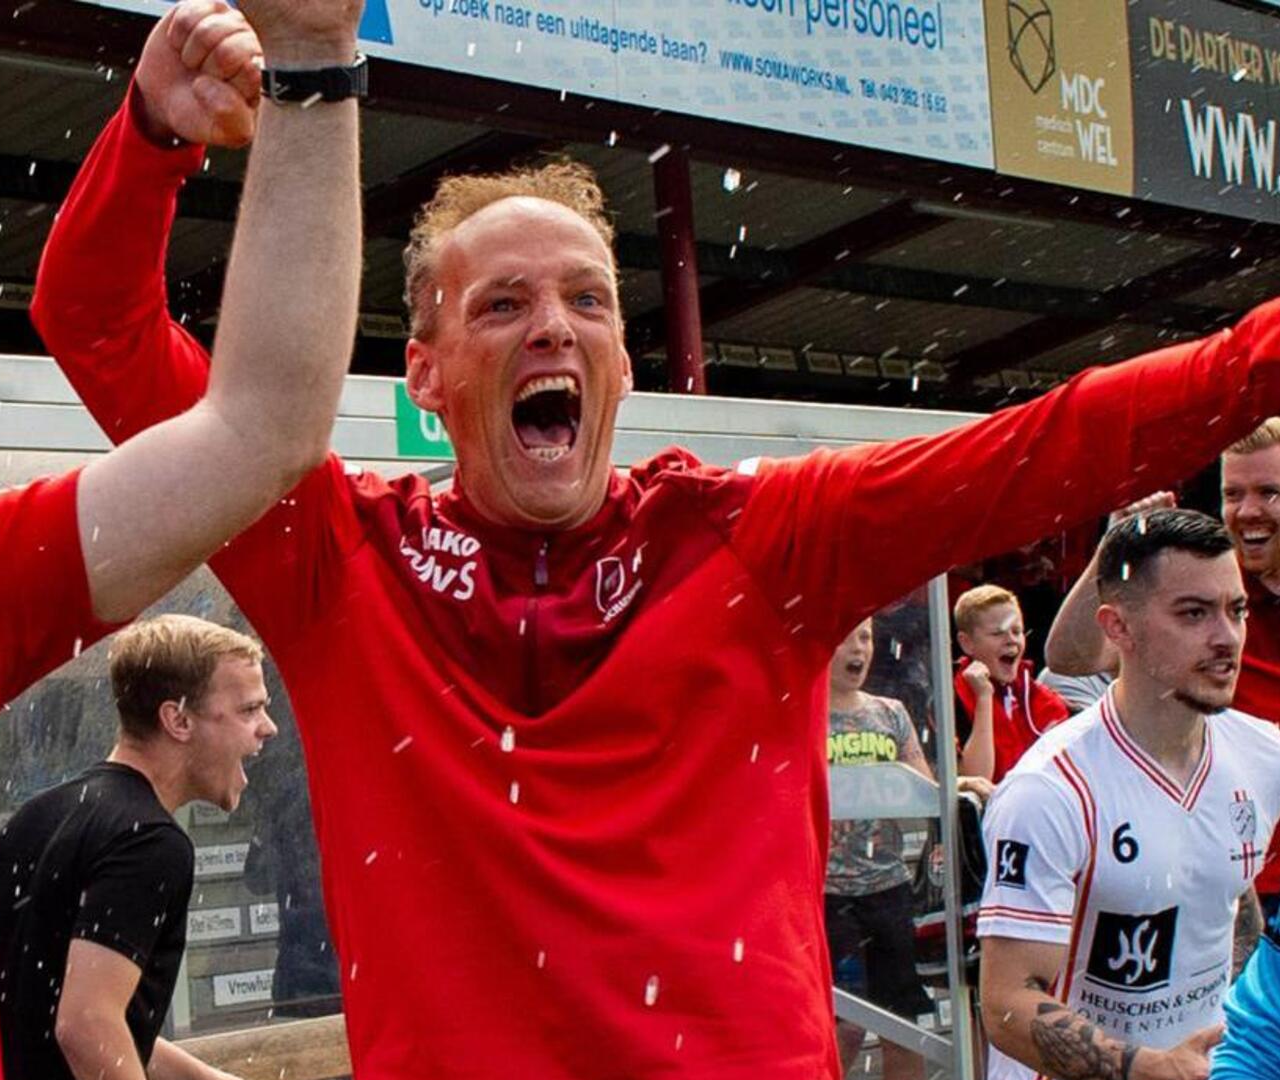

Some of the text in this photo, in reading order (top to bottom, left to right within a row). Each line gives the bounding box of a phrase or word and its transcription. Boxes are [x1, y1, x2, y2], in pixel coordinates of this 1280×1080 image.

[495, 4, 532, 28] naar
[536, 10, 566, 36] een
[570, 16, 658, 53] uitdagende
[661, 34, 708, 64] baan?
[806, 0, 944, 49] personeel
[1149, 17, 1176, 61] DE
[1179, 24, 1263, 84] PARTNER
[1060, 68, 1107, 119] MDC
[1075, 119, 1118, 166] WEL
[422, 526, 481, 557] JAKO
[1111, 821, 1140, 864] 6
[1077, 1007, 1184, 1033] ORIENTAL
[1079, 987, 1170, 1017] HEUSCHEN
